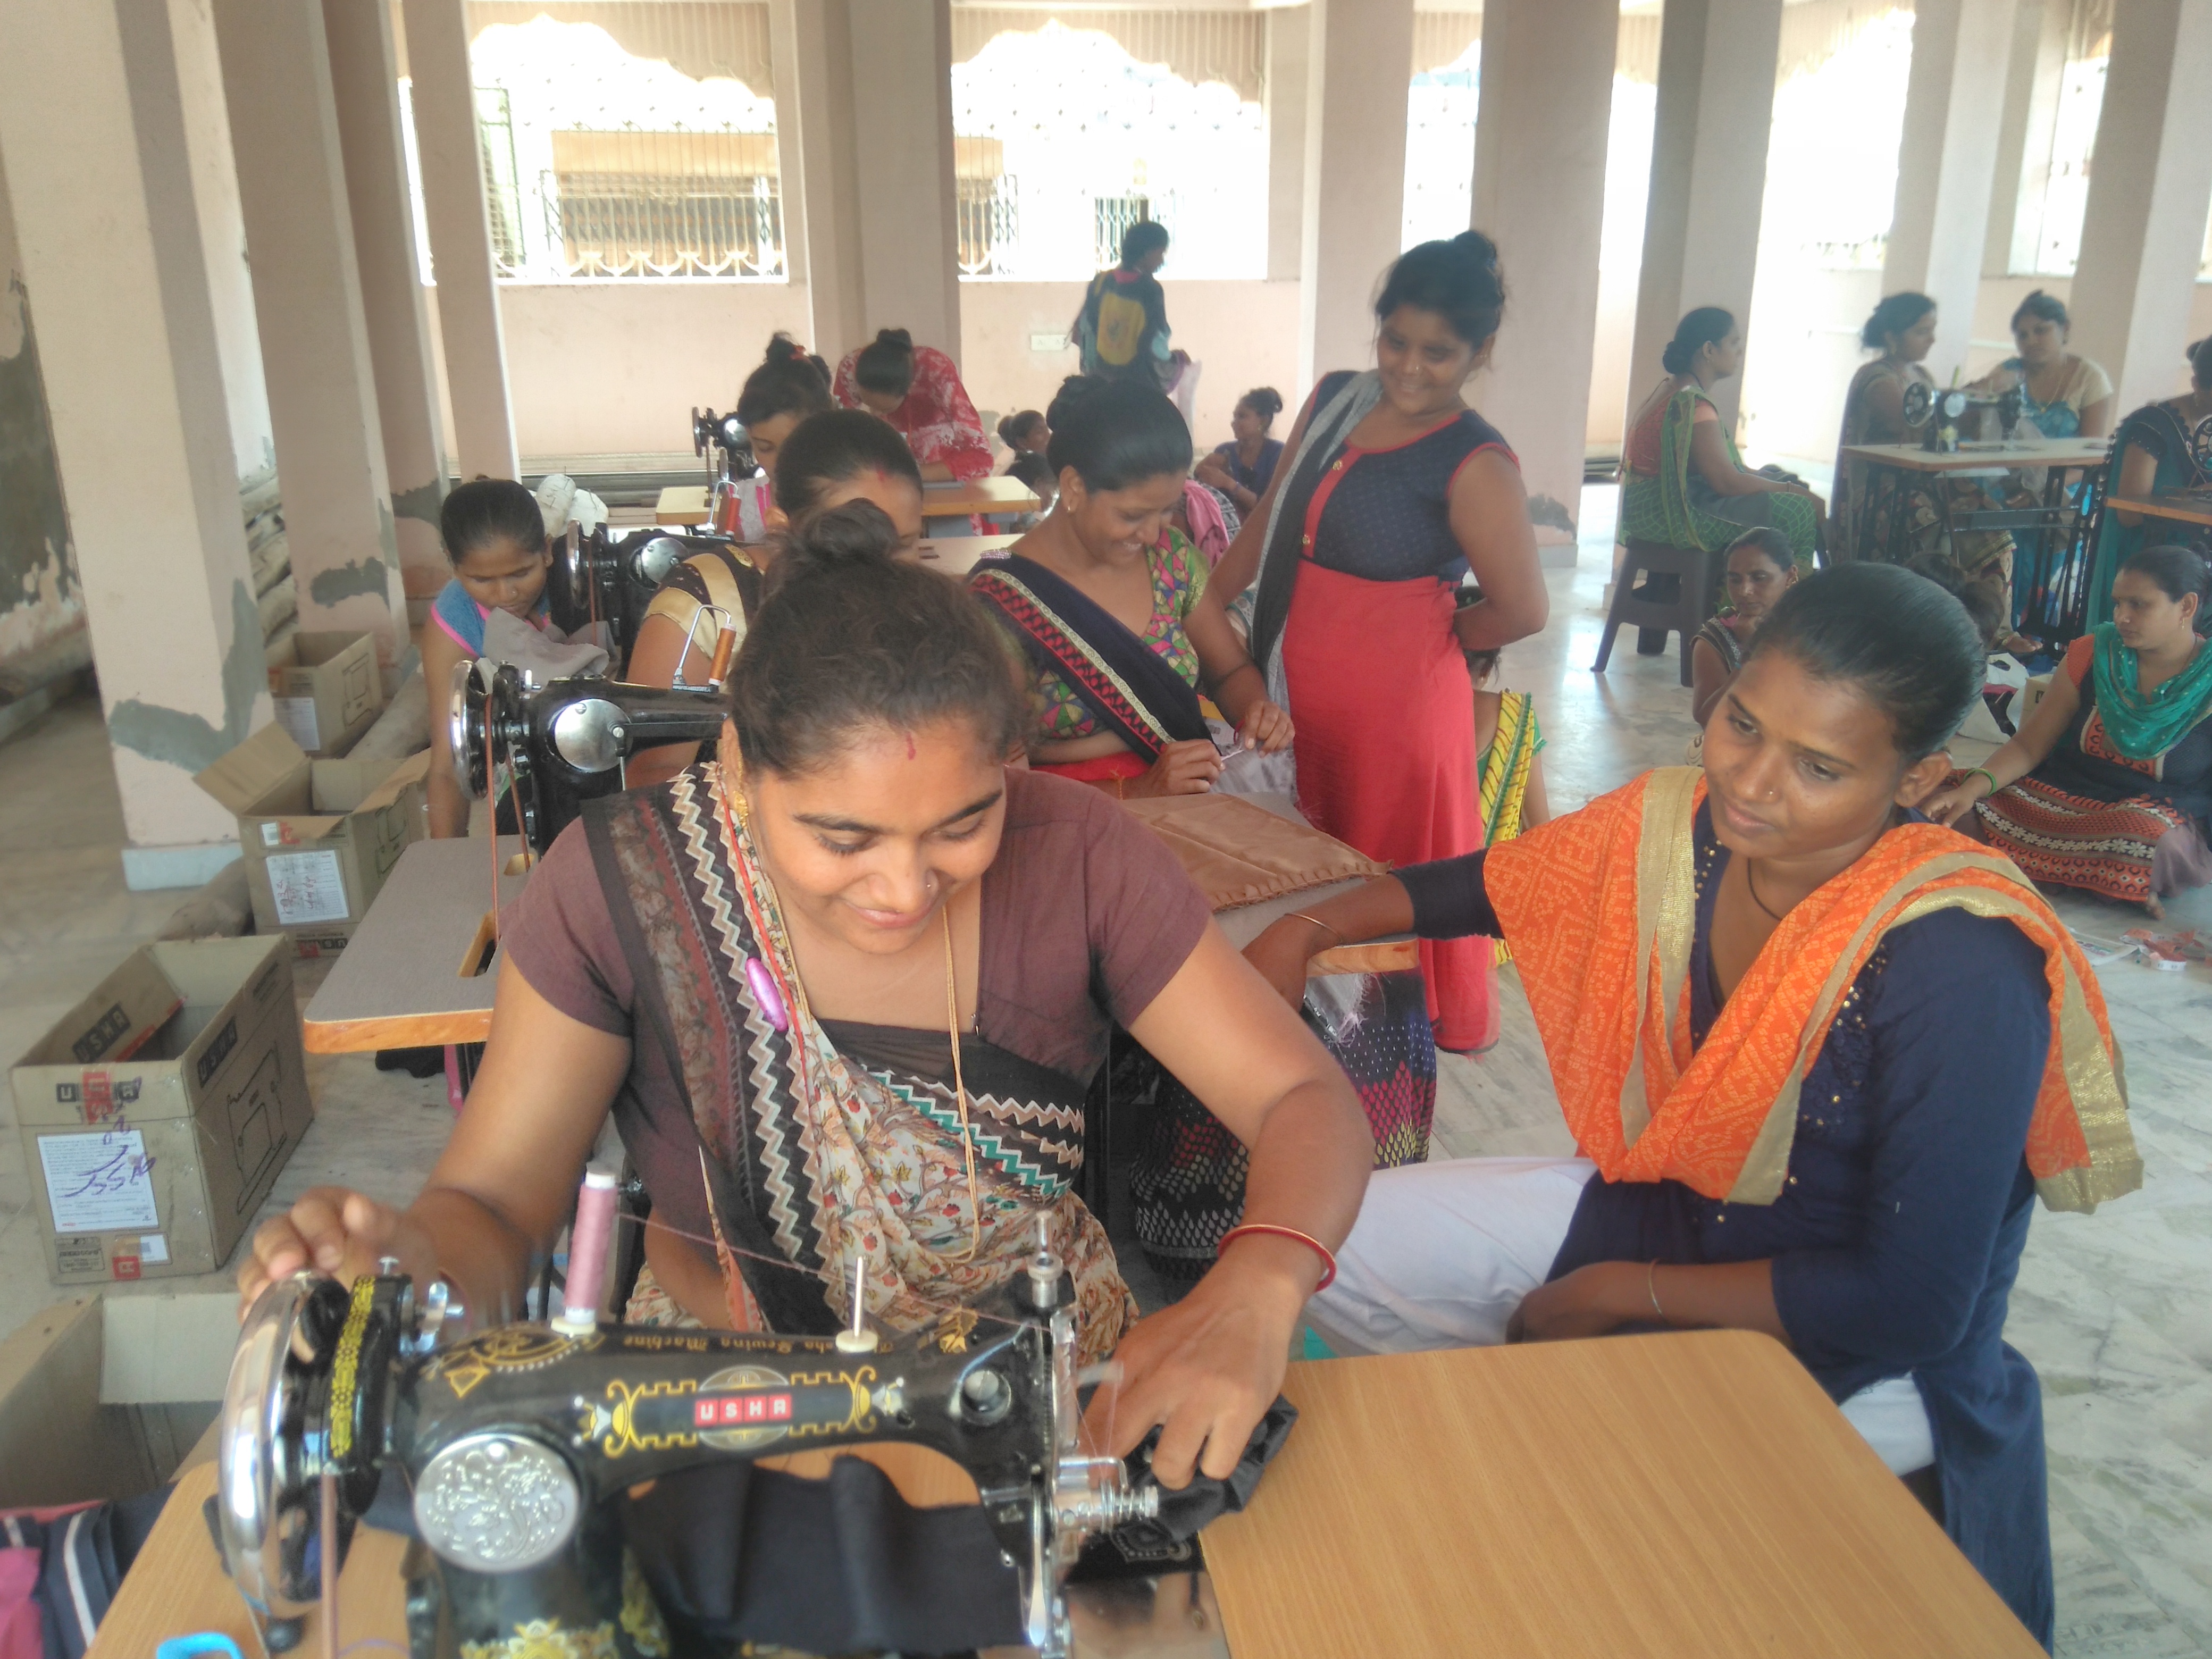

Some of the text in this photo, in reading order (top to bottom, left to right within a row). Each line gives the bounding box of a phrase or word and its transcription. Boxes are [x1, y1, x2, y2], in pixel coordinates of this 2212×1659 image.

[622, 1334, 709, 1352] Machine
[720, 1336, 792, 1354] Sewing
[698, 1396, 789, 1423] USHA
